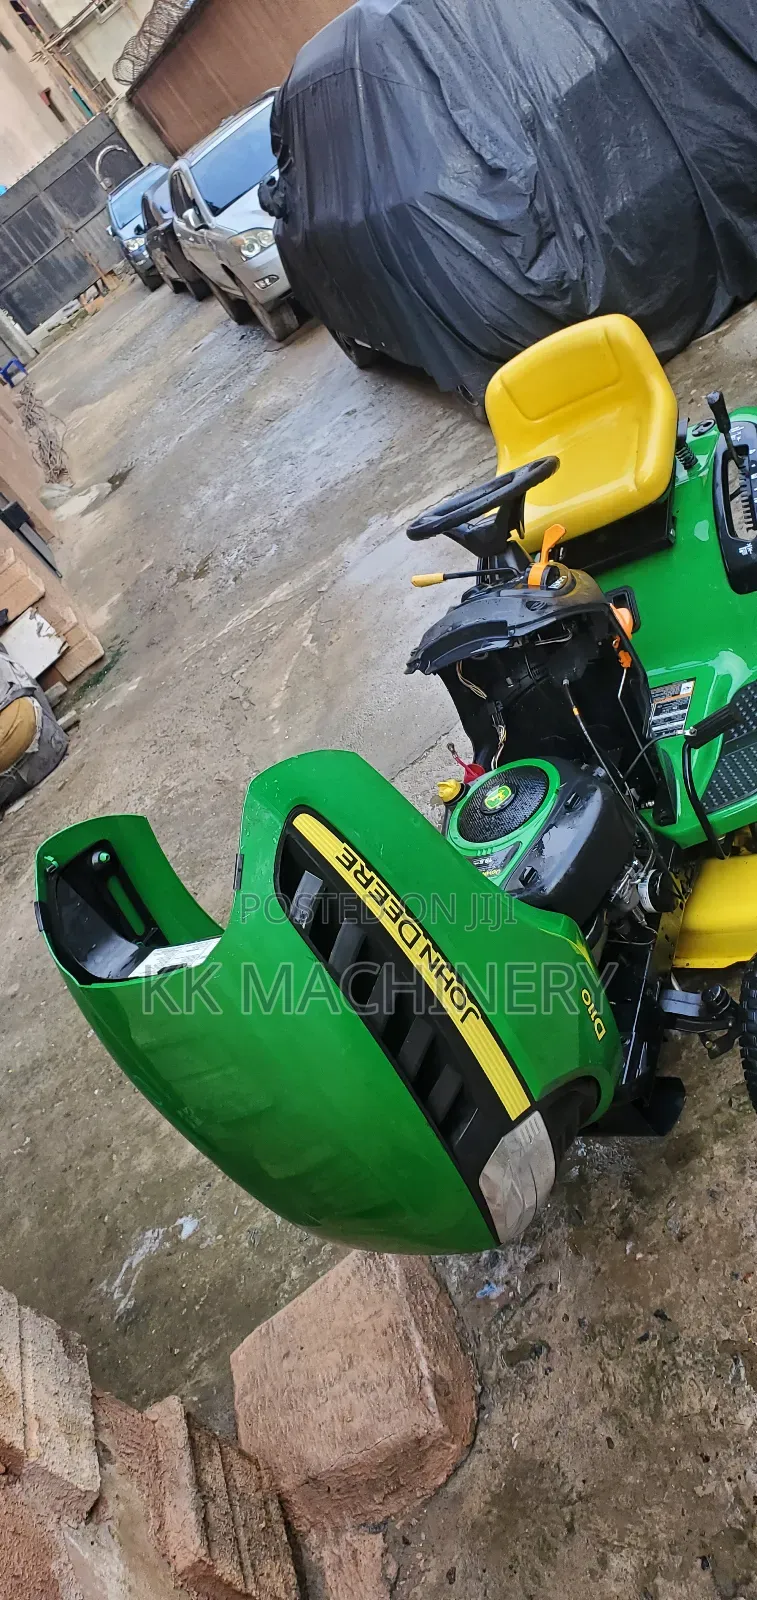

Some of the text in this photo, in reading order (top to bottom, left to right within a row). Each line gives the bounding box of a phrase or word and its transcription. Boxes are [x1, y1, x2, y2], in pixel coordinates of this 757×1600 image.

[335, 846, 480, 1023] JOHN DEERE
[581, 988, 607, 1041] D110
